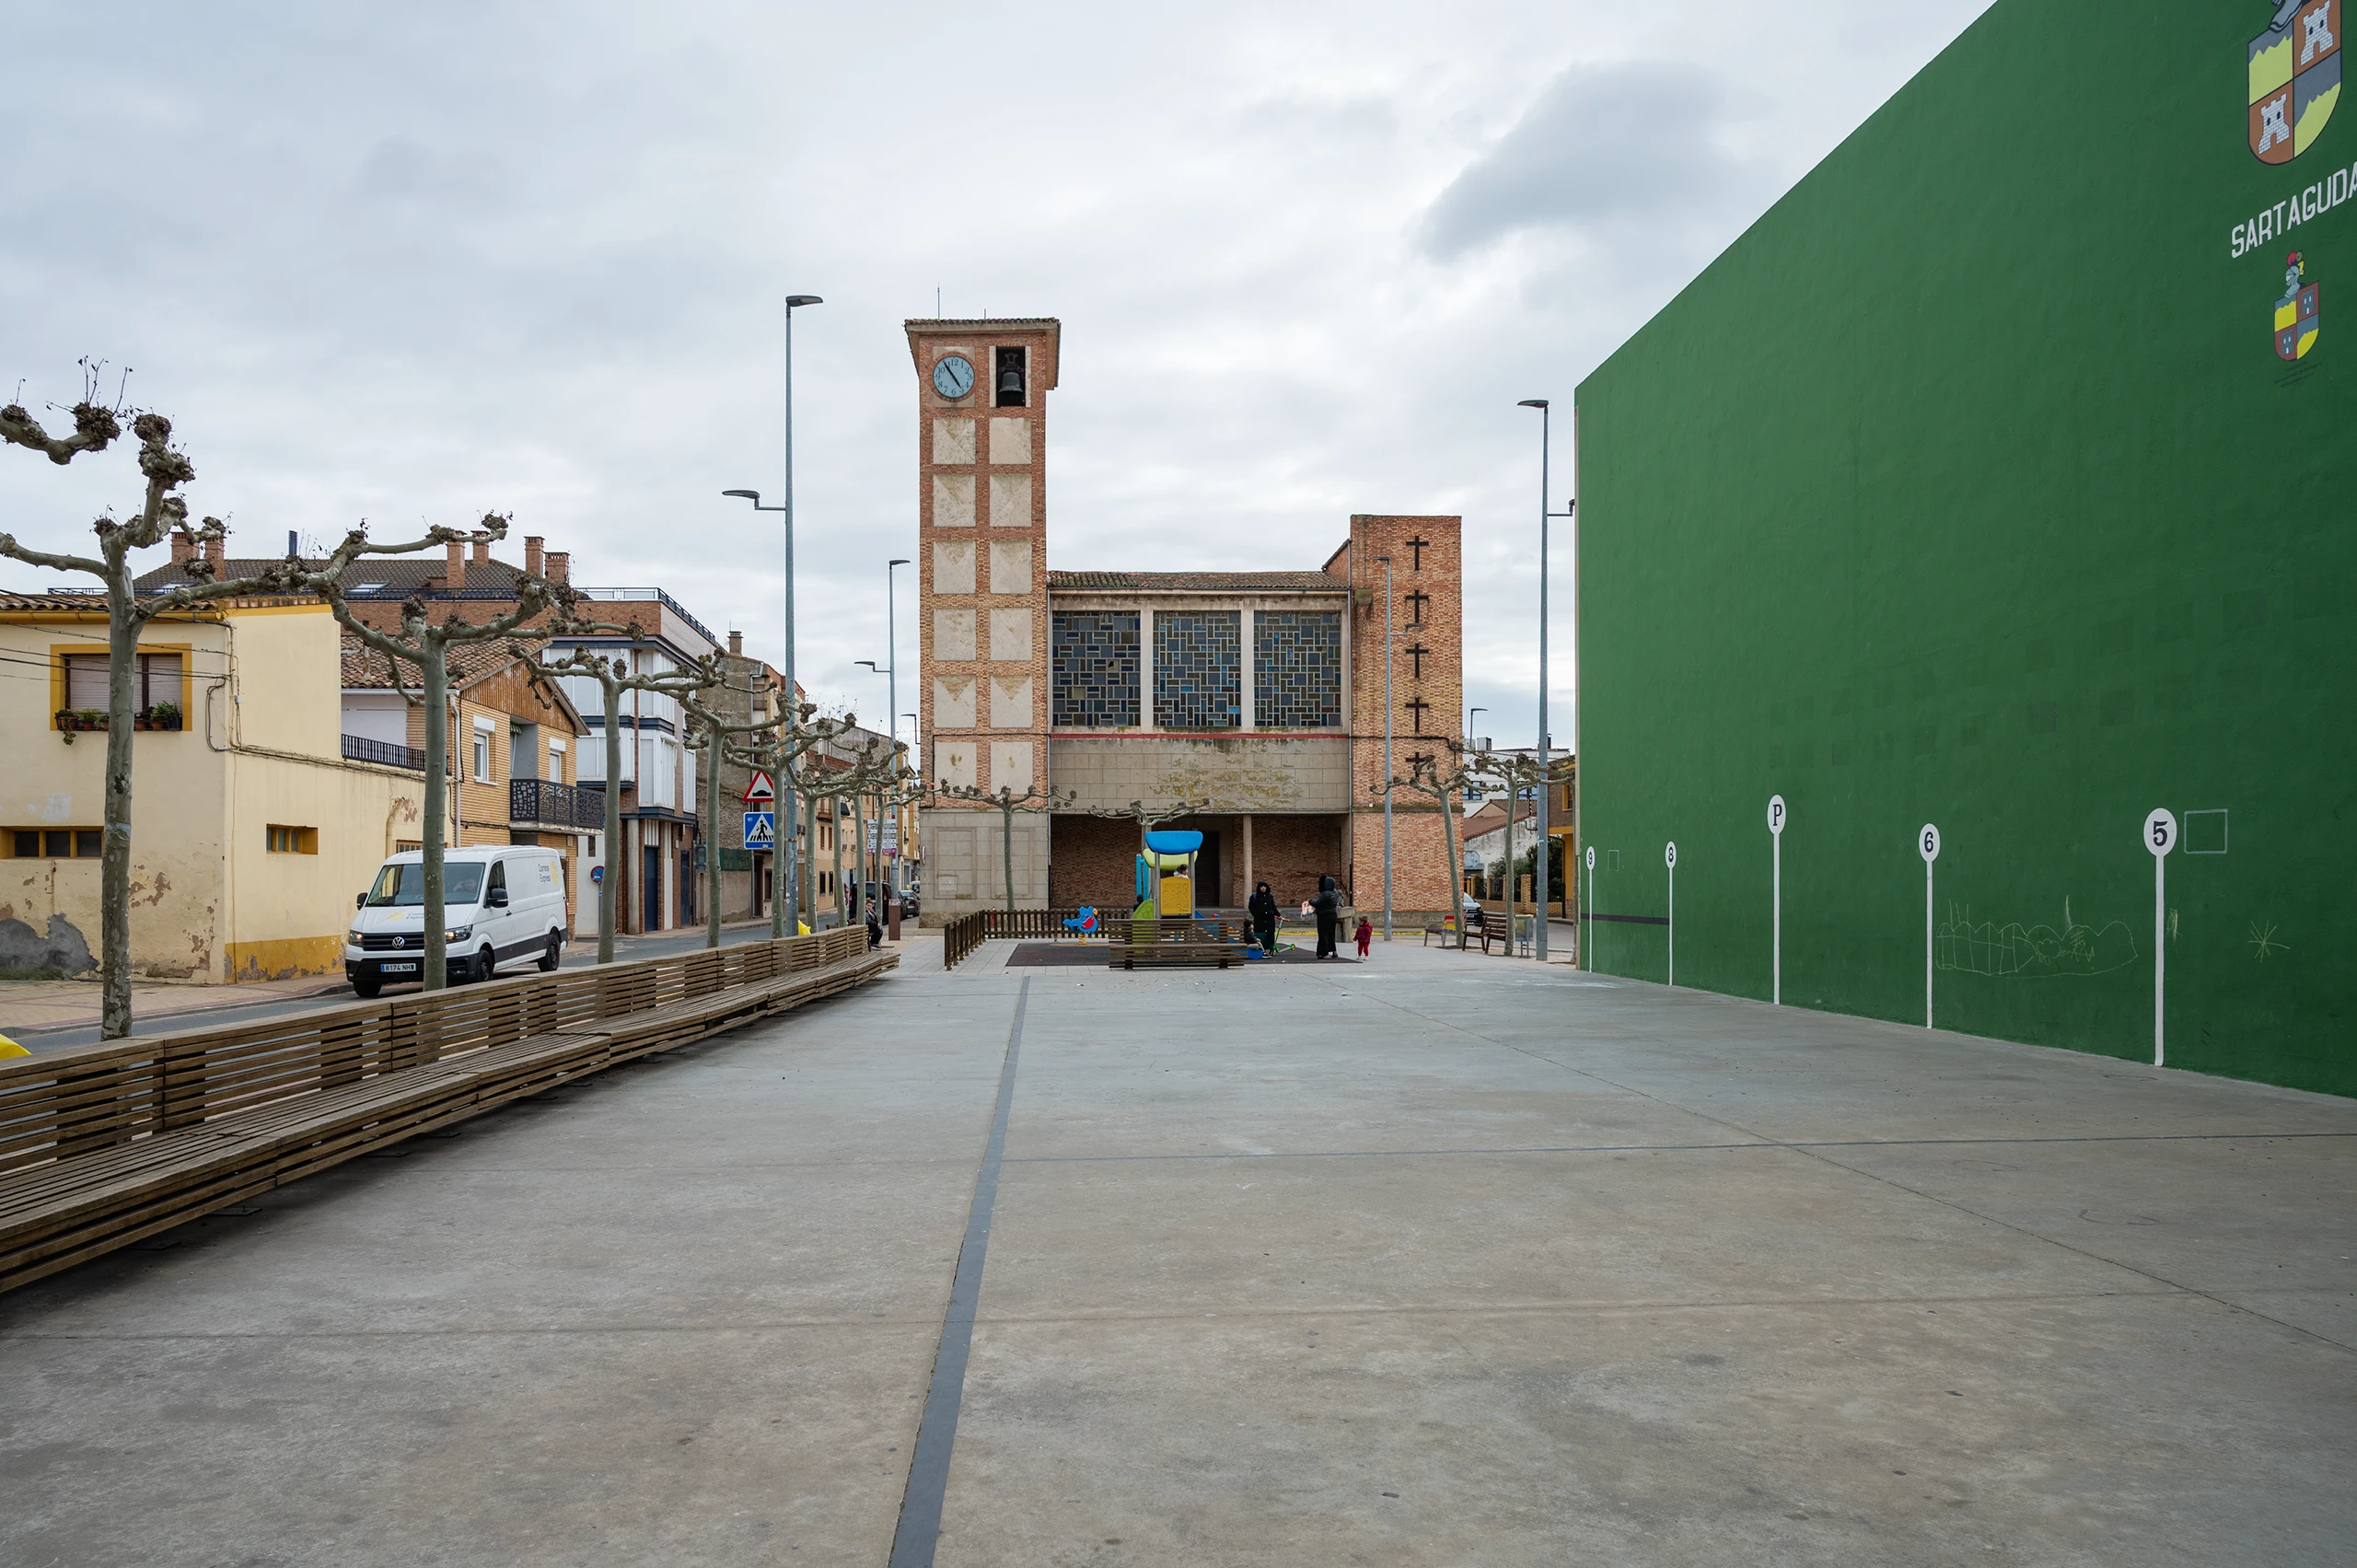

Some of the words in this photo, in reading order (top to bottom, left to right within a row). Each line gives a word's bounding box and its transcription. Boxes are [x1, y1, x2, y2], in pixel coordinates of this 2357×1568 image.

[2231, 160, 2357, 259] SARTAGUDA
[935, 373, 941, 381] 9
[967, 373, 972, 381] 3
[944, 386, 948, 394] 7
[1772, 804, 1782, 827] P
[1924, 831, 1933, 853] 6
[2153, 820, 2168, 847] 5
[1588, 852, 1593, 865] 9
[1668, 846, 1674, 863] 8
